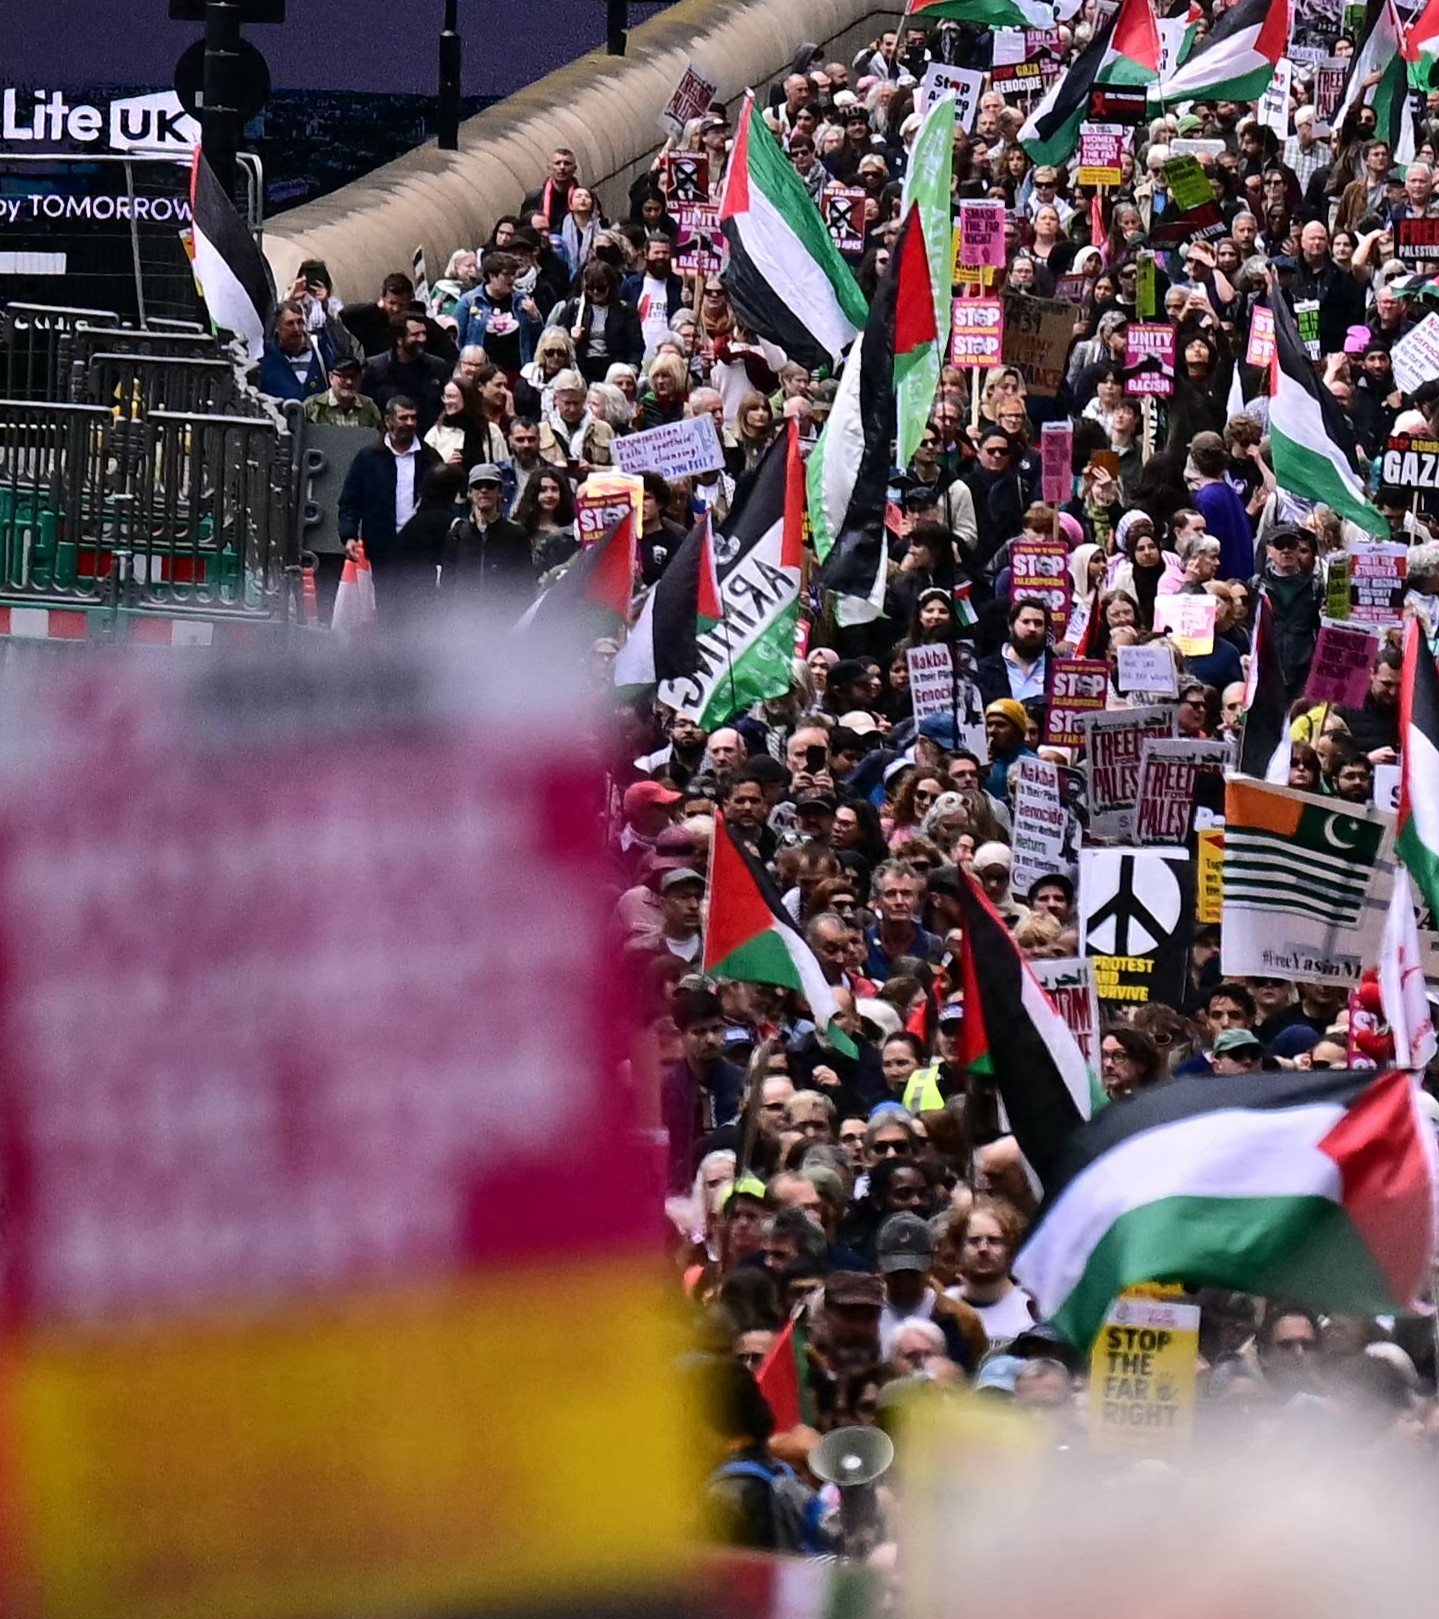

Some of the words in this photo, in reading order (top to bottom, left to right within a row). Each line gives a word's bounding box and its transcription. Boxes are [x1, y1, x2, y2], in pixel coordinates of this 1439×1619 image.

[1015, 63, 1040, 77] GAZA
[934, 74, 971, 94] Stop
[993, 77, 1042, 94] GENOCIDE
[3, 88, 103, 141] Lite
[119, 107, 191, 143] UK
[28, 194, 193, 221] TOMORROW
[954, 308, 1000, 327] STOP
[954, 336, 999, 356] STOP
[1128, 332, 1173, 348] UNITY
[1128, 379, 1171, 393] RACISM
[1013, 554, 1066, 577] STOP
[911, 649, 949, 671] Nakba
[914, 685, 952, 704] Genoci
[1053, 673, 1105, 697] STOP
[1091, 726, 1173, 767] FREED
[1020, 762, 1056, 788] Nakba
[1092, 764, 1139, 809] PALES
[1018, 801, 1064, 826] Genocide
[1137, 797, 1190, 842] PALES
[1016, 834, 1047, 855] Return
[1092, 955, 1155, 973] PROTEST
[1262, 947, 1363, 980] #FreeYasinM
[1096, 984, 1149, 1002] URVIVE
[1107, 1326, 1173, 1352] STOP
[1106, 1351, 1154, 1376] THE
[1103, 1375, 1150, 1400] FAR
[1102, 1400, 1180, 1427] RIGHT
